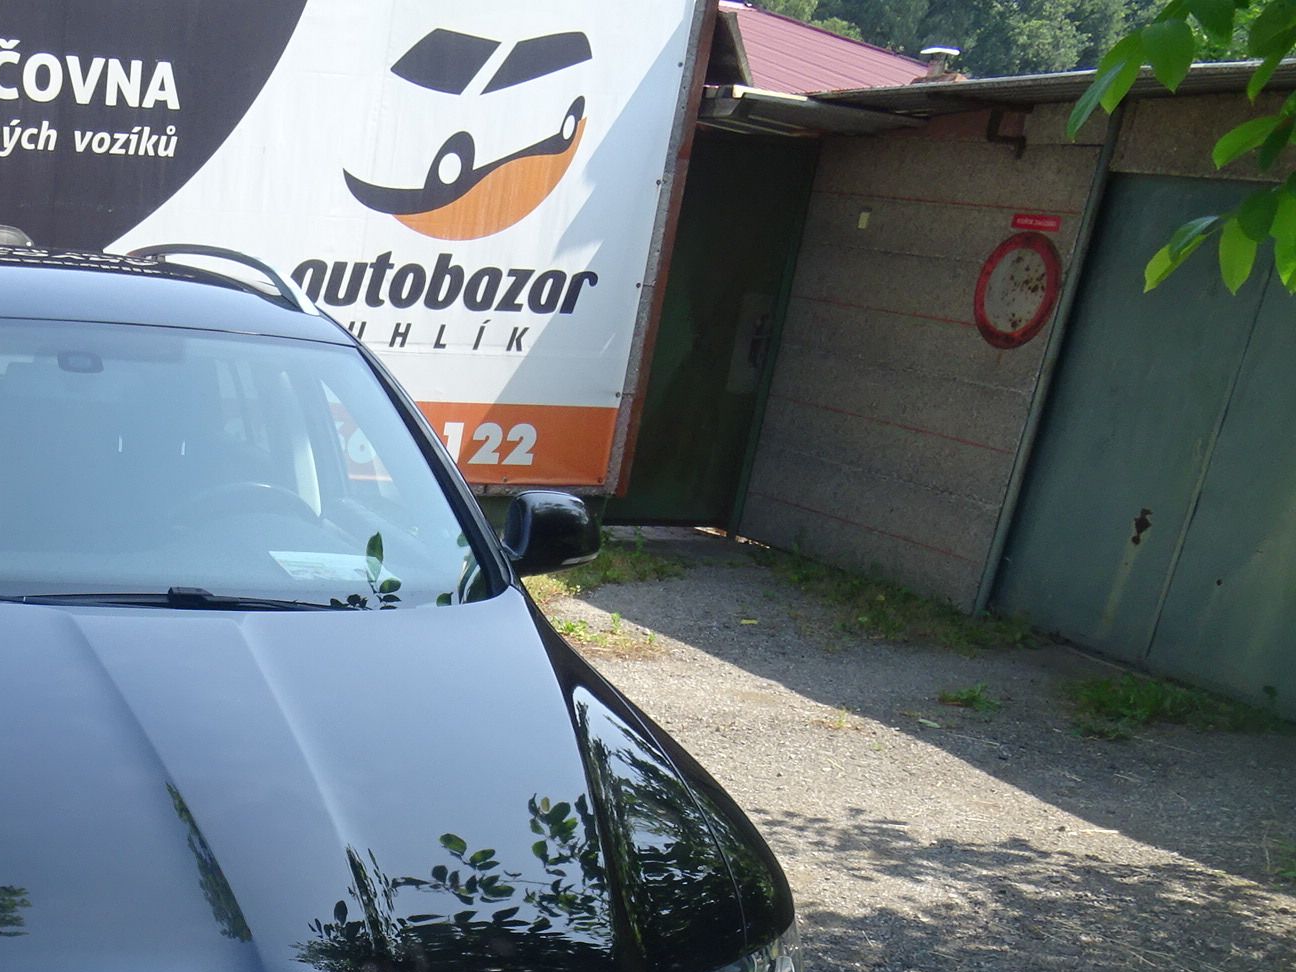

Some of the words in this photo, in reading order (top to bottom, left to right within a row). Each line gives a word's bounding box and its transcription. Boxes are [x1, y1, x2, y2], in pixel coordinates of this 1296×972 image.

[73, 125, 179, 158] vozíků
[290, 250, 599, 315] autobazar
[443, 422, 537, 465] 122
